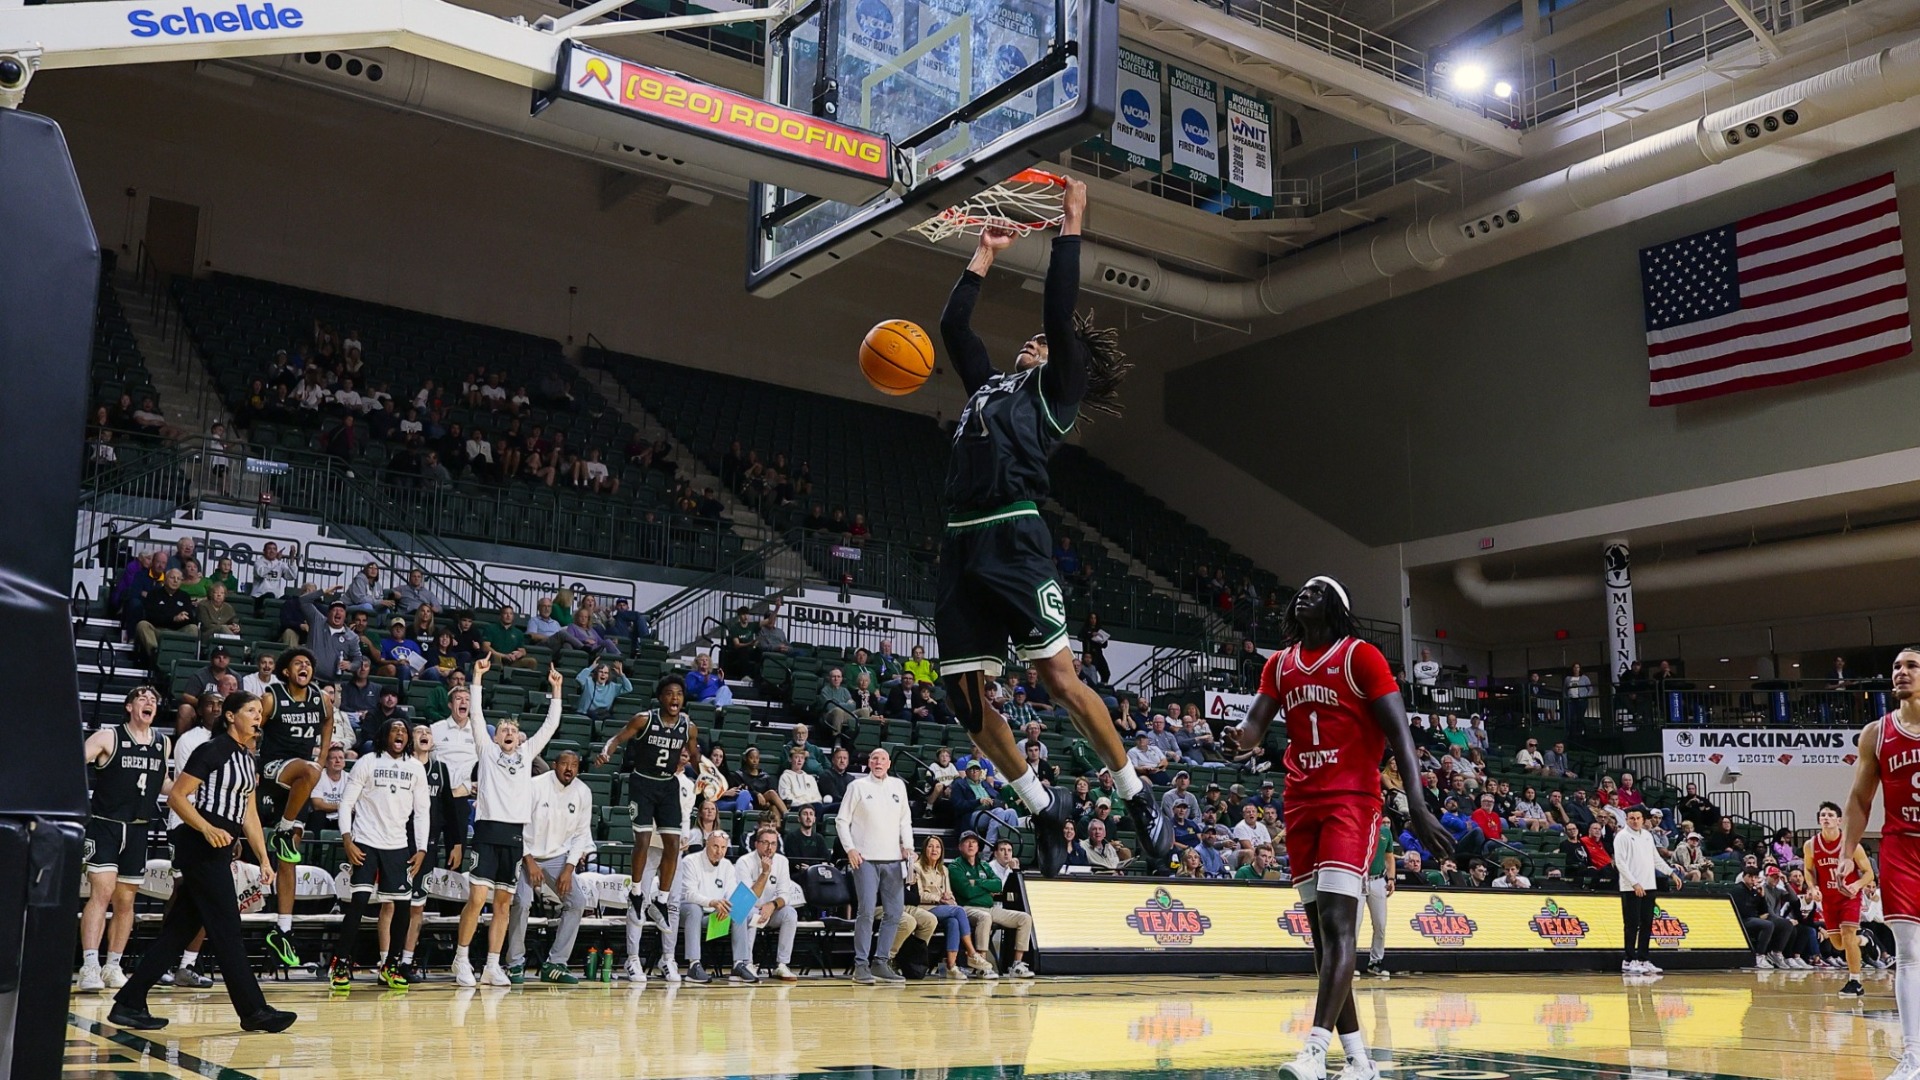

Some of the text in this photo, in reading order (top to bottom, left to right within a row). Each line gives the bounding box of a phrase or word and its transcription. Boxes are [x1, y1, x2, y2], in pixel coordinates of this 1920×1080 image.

[127, 2, 304, 38] Schelde
[793, 40, 811, 53] 013
[1118, 49, 1155, 70] WOMEN'S
[1118, 59, 1160, 82] ASKETBALL
[1175, 69, 1211, 91] WOMEN'S
[1170, 76, 1216, 102] BASKETBALL
[1123, 104, 1151, 121] NCAA
[1228, 100, 1269, 123] BASKETBALL
[1232, 93, 1265, 113] WOMEN'S
[625, 73, 882, 163] (920) ROOFING
[1116, 121, 1156, 143] FIRST ROUND
[1184, 122, 1210, 139] NCAA
[1230, 117, 1267, 143] WNIT
[1127, 152, 1146, 167] 2024
[1178, 139, 1216, 161] FIRST ROUND
[1188, 169, 1207, 184] 2025
[519, 579, 565, 594] CIRCL
[795, 606, 892, 632] BUD LIGHT
[1612, 592, 1631, 681] MACKINA
[1285, 684, 1340, 711] ILLINOIS
[281, 711, 320, 724] GREEN BAY
[1309, 710, 1320, 746] 1
[647, 735, 671, 748] GREEN
[1699, 732, 1845, 748] MACKINAWS
[121, 755, 162, 772] GREEN BAY
[655, 748, 670, 768] 2
[1298, 748, 1340, 769] STATE
[1668, 753, 1839, 764] LEGIT LEGIT LEGIT
[1887, 748, 1920, 773] ILLI
[136, 773, 148, 796] 4
[373, 768, 414, 781] GREEN BAY
[1137, 911, 1201, 933] TEXAS
[1418, 916, 1471, 935] TEXAS
[1535, 917, 1583, 936] TEXAS
[1652, 918, 1683, 936] EXAS
[1156, 934, 1192, 943] ROADHOUSE
